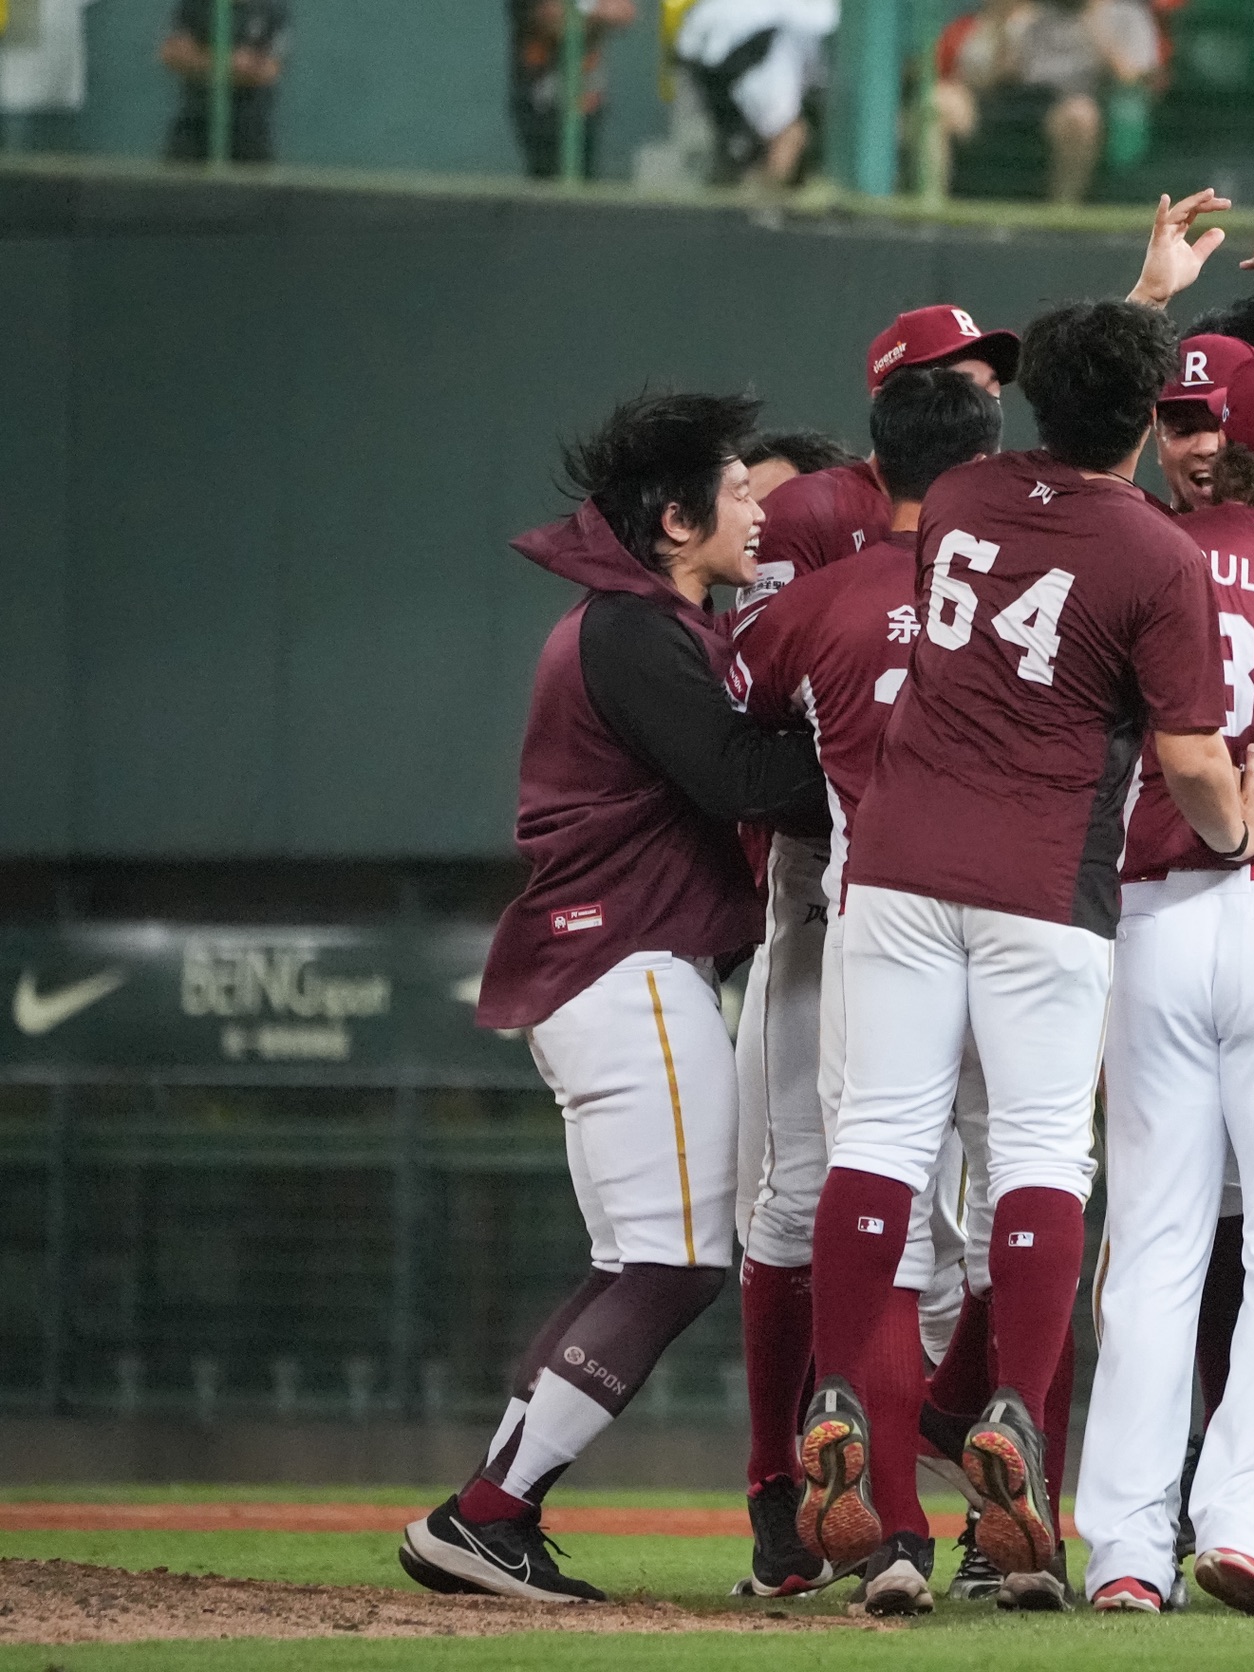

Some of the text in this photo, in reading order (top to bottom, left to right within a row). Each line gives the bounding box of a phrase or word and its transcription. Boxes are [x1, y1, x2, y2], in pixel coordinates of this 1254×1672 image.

[951, 309, 981, 337] R
[1183, 351, 1211, 385] R
[926, 529, 1076, 686] 64
